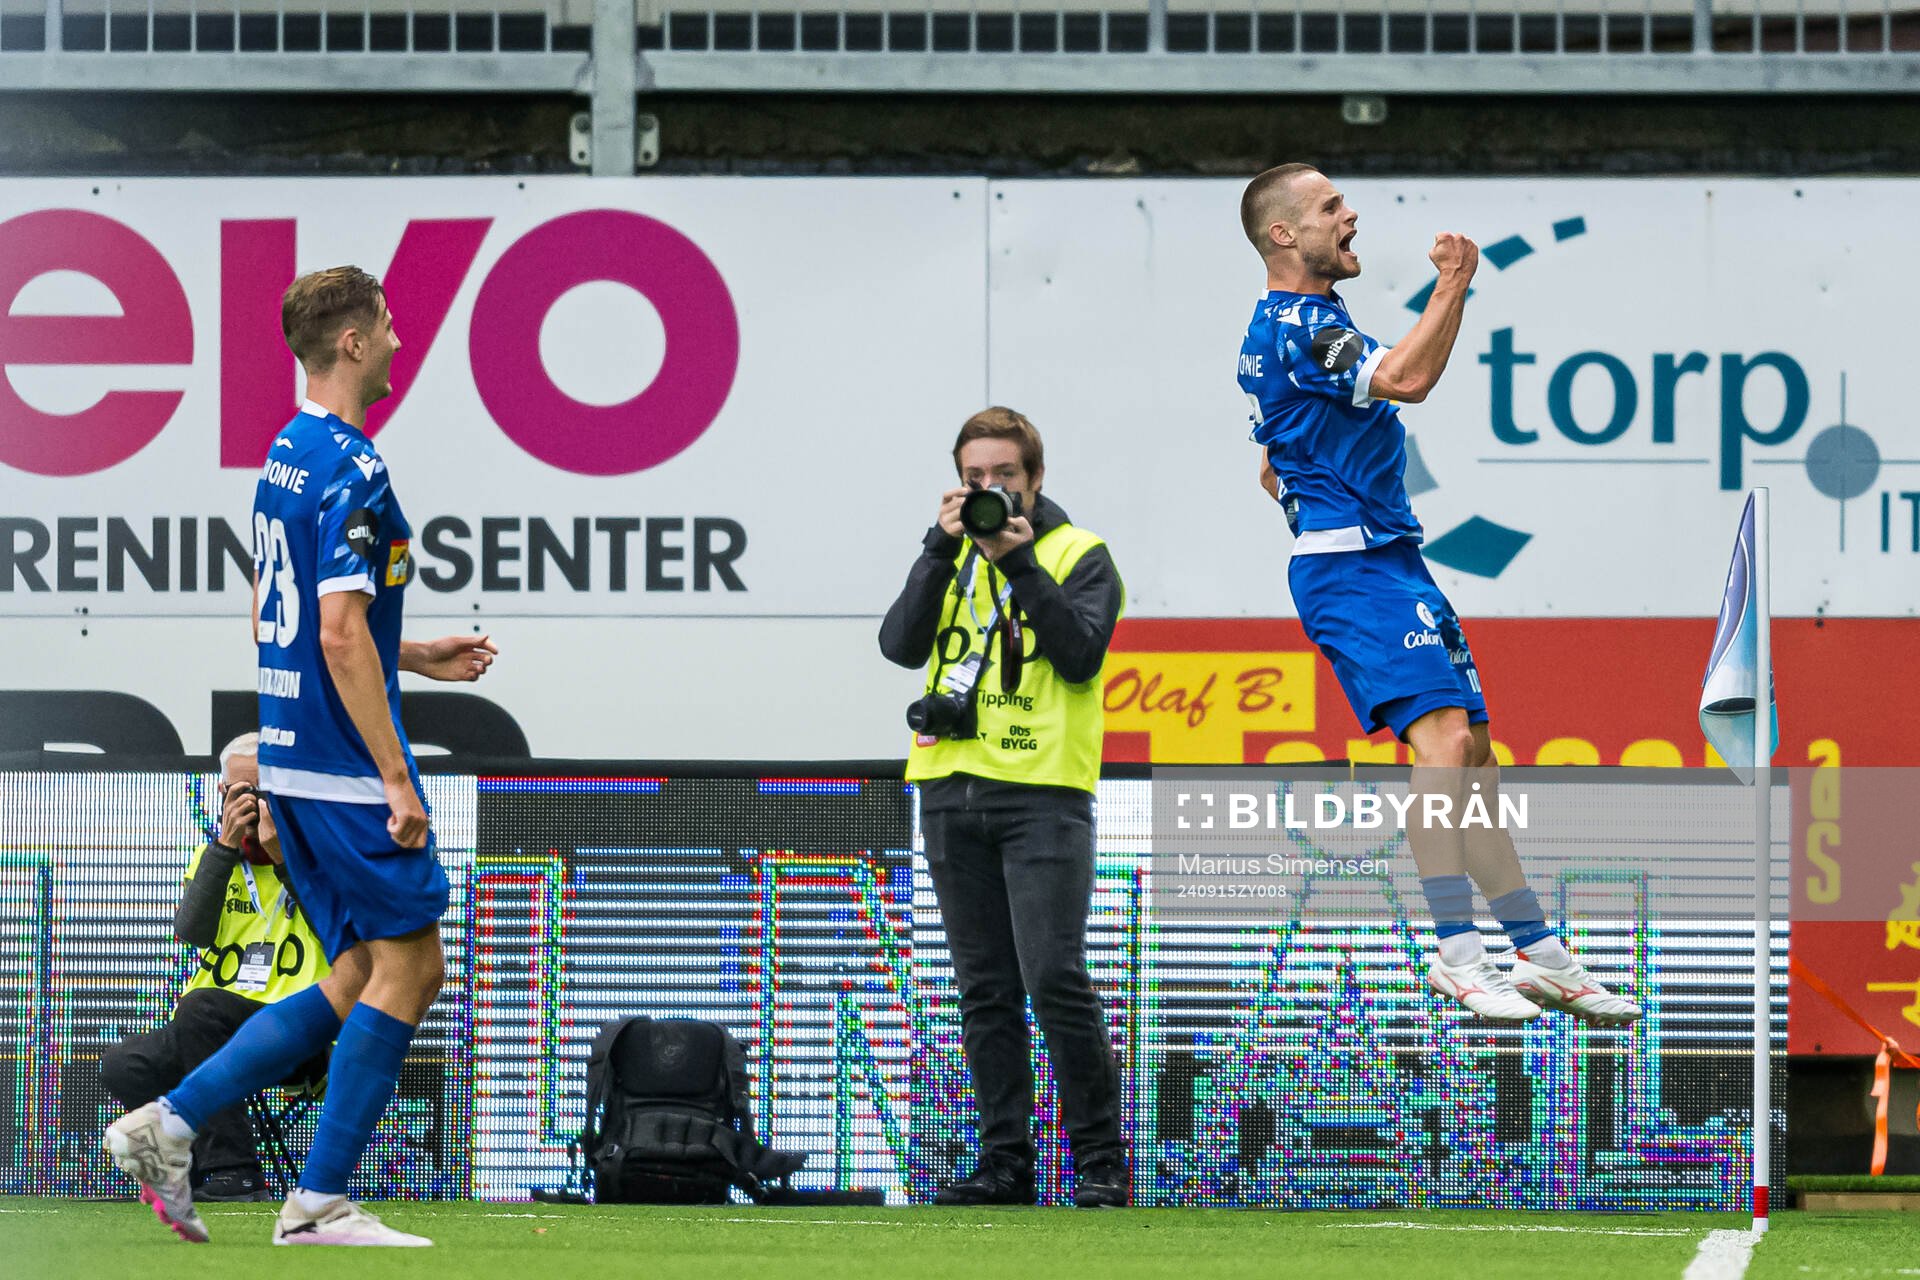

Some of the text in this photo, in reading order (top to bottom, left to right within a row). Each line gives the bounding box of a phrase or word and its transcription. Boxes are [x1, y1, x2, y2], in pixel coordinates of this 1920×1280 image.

[0, 208, 740, 476] evo
[1478, 327, 1810, 490] torp
[1001, 738, 1037, 750] BYGG
[1103, 667, 1292, 727] Olaf B.
